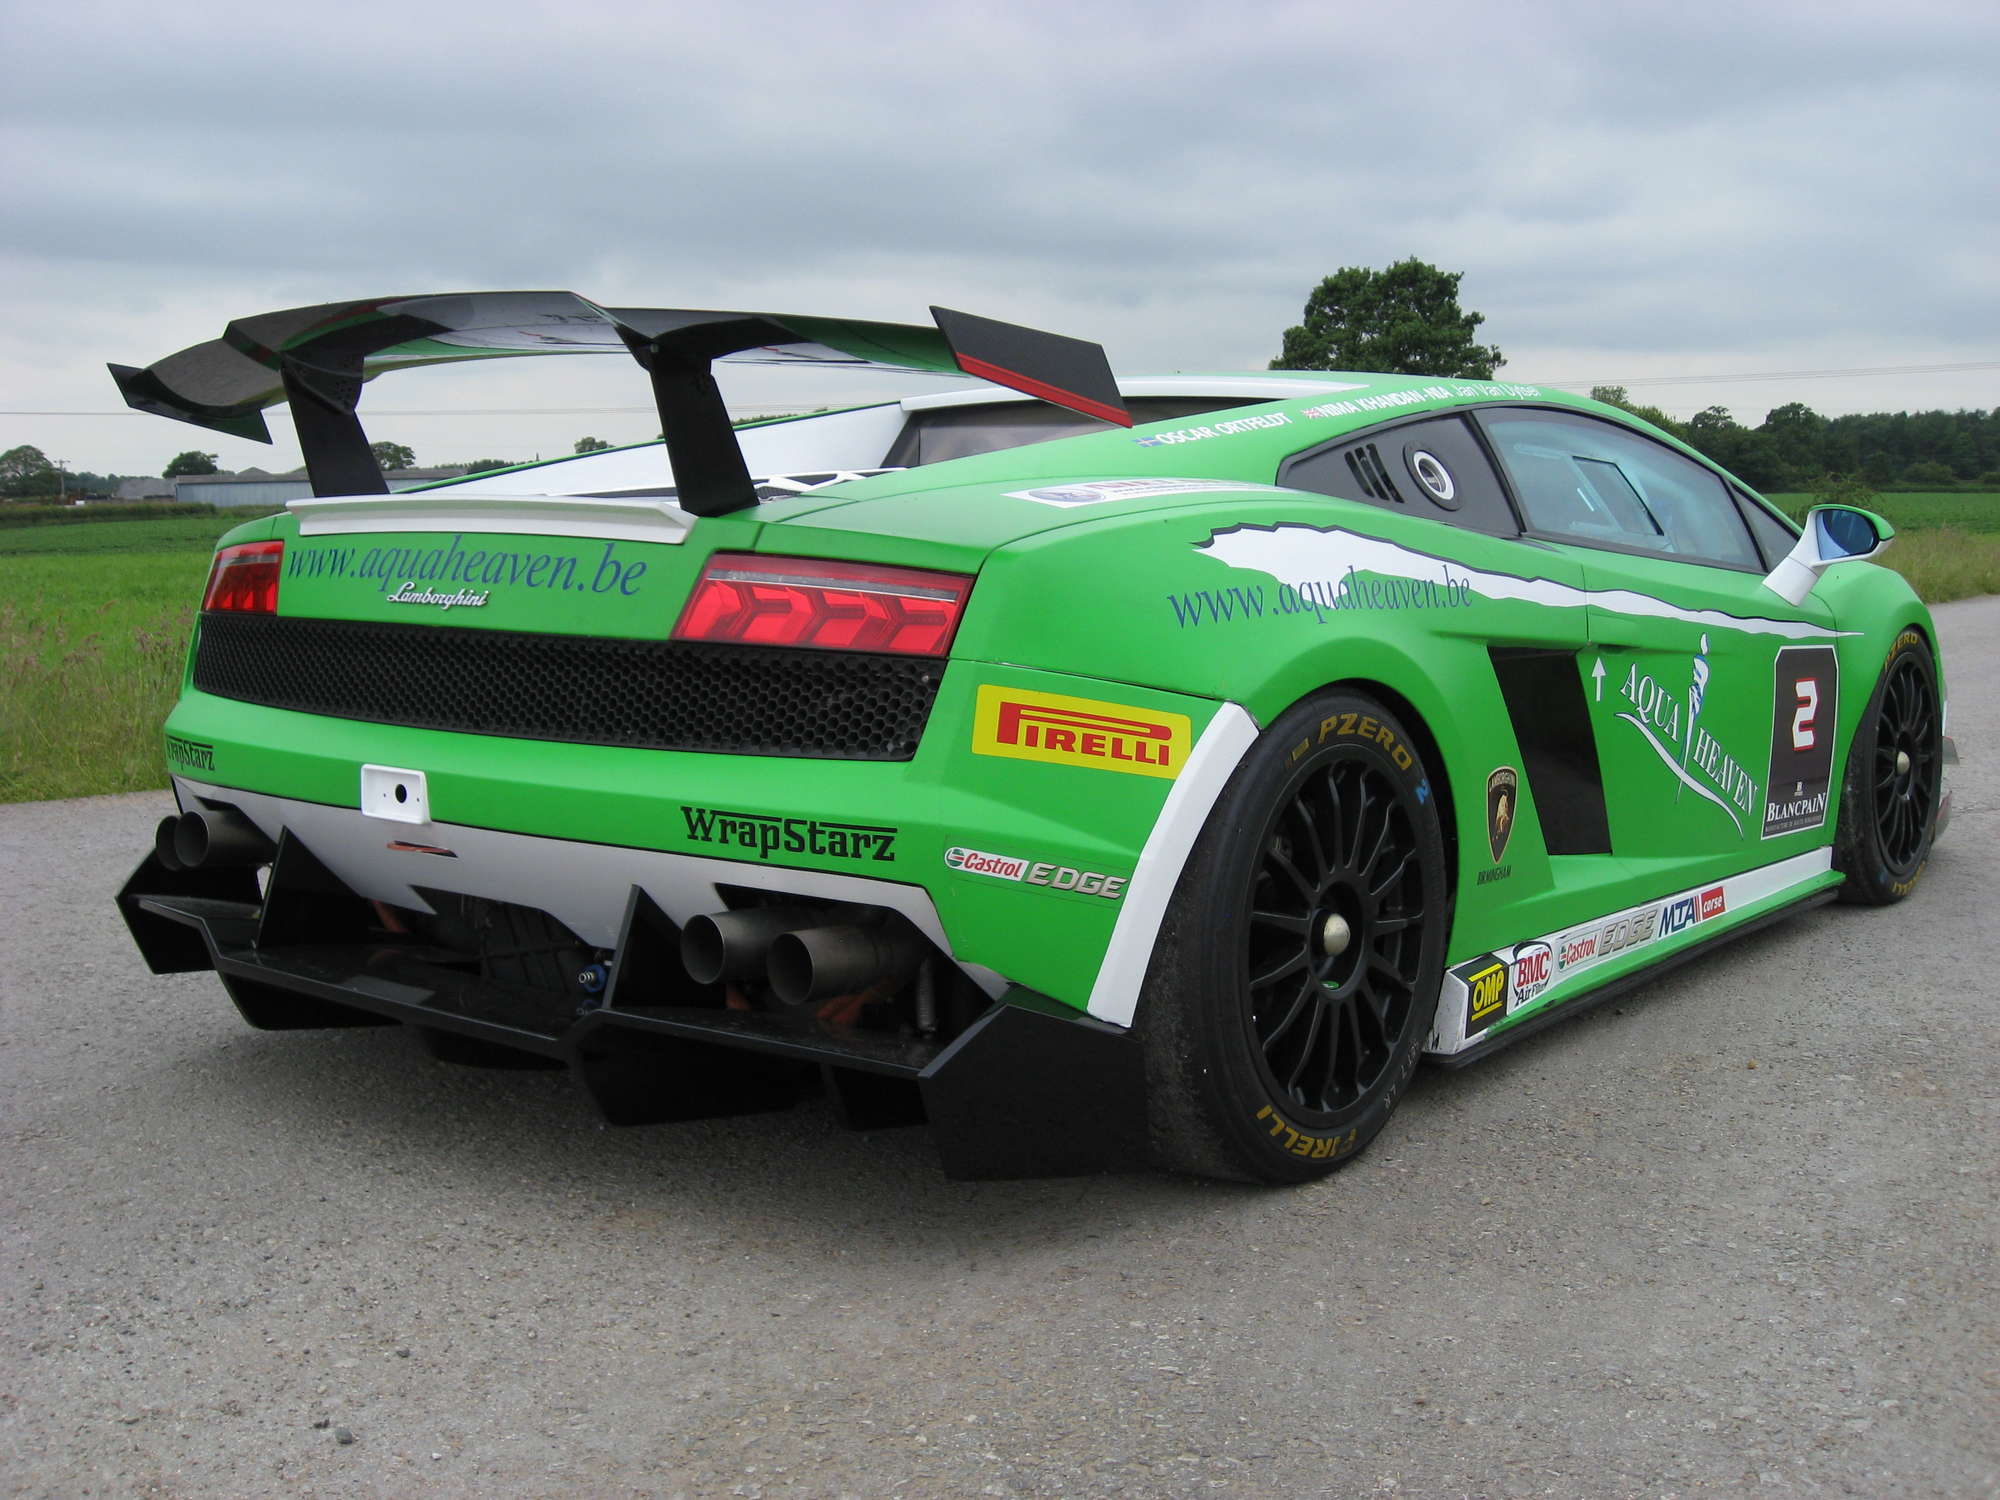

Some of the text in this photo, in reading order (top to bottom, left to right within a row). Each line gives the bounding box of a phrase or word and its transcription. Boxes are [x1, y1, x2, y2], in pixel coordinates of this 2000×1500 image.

[1155, 412, 1293, 445] OSCAR ORTFELDT
[1315, 400, 1361, 418] NIMA
[287, 534, 648, 596] www.aquaheaven.be
[386, 581, 490, 611] Lamborghini
[1167, 564, 1473, 629] www.aquaheaven.be
[996, 701, 1172, 767] PIRELLI
[1792, 677, 1818, 751] 2
[1620, 663, 1759, 816] AQUA HEAVEN
[1766, 792, 1827, 822] BLANCPAIN
[680, 805, 898, 862] WrapStarz
[964, 852, 1128, 899] Castrol EDGE
[1703, 896, 1723, 914] corse
[1566, 910, 1658, 964] Castrol EDGE
[1473, 970, 1505, 1012] OMP
[1516, 951, 1550, 988] BMC
[1514, 985, 1533, 1006] Air
